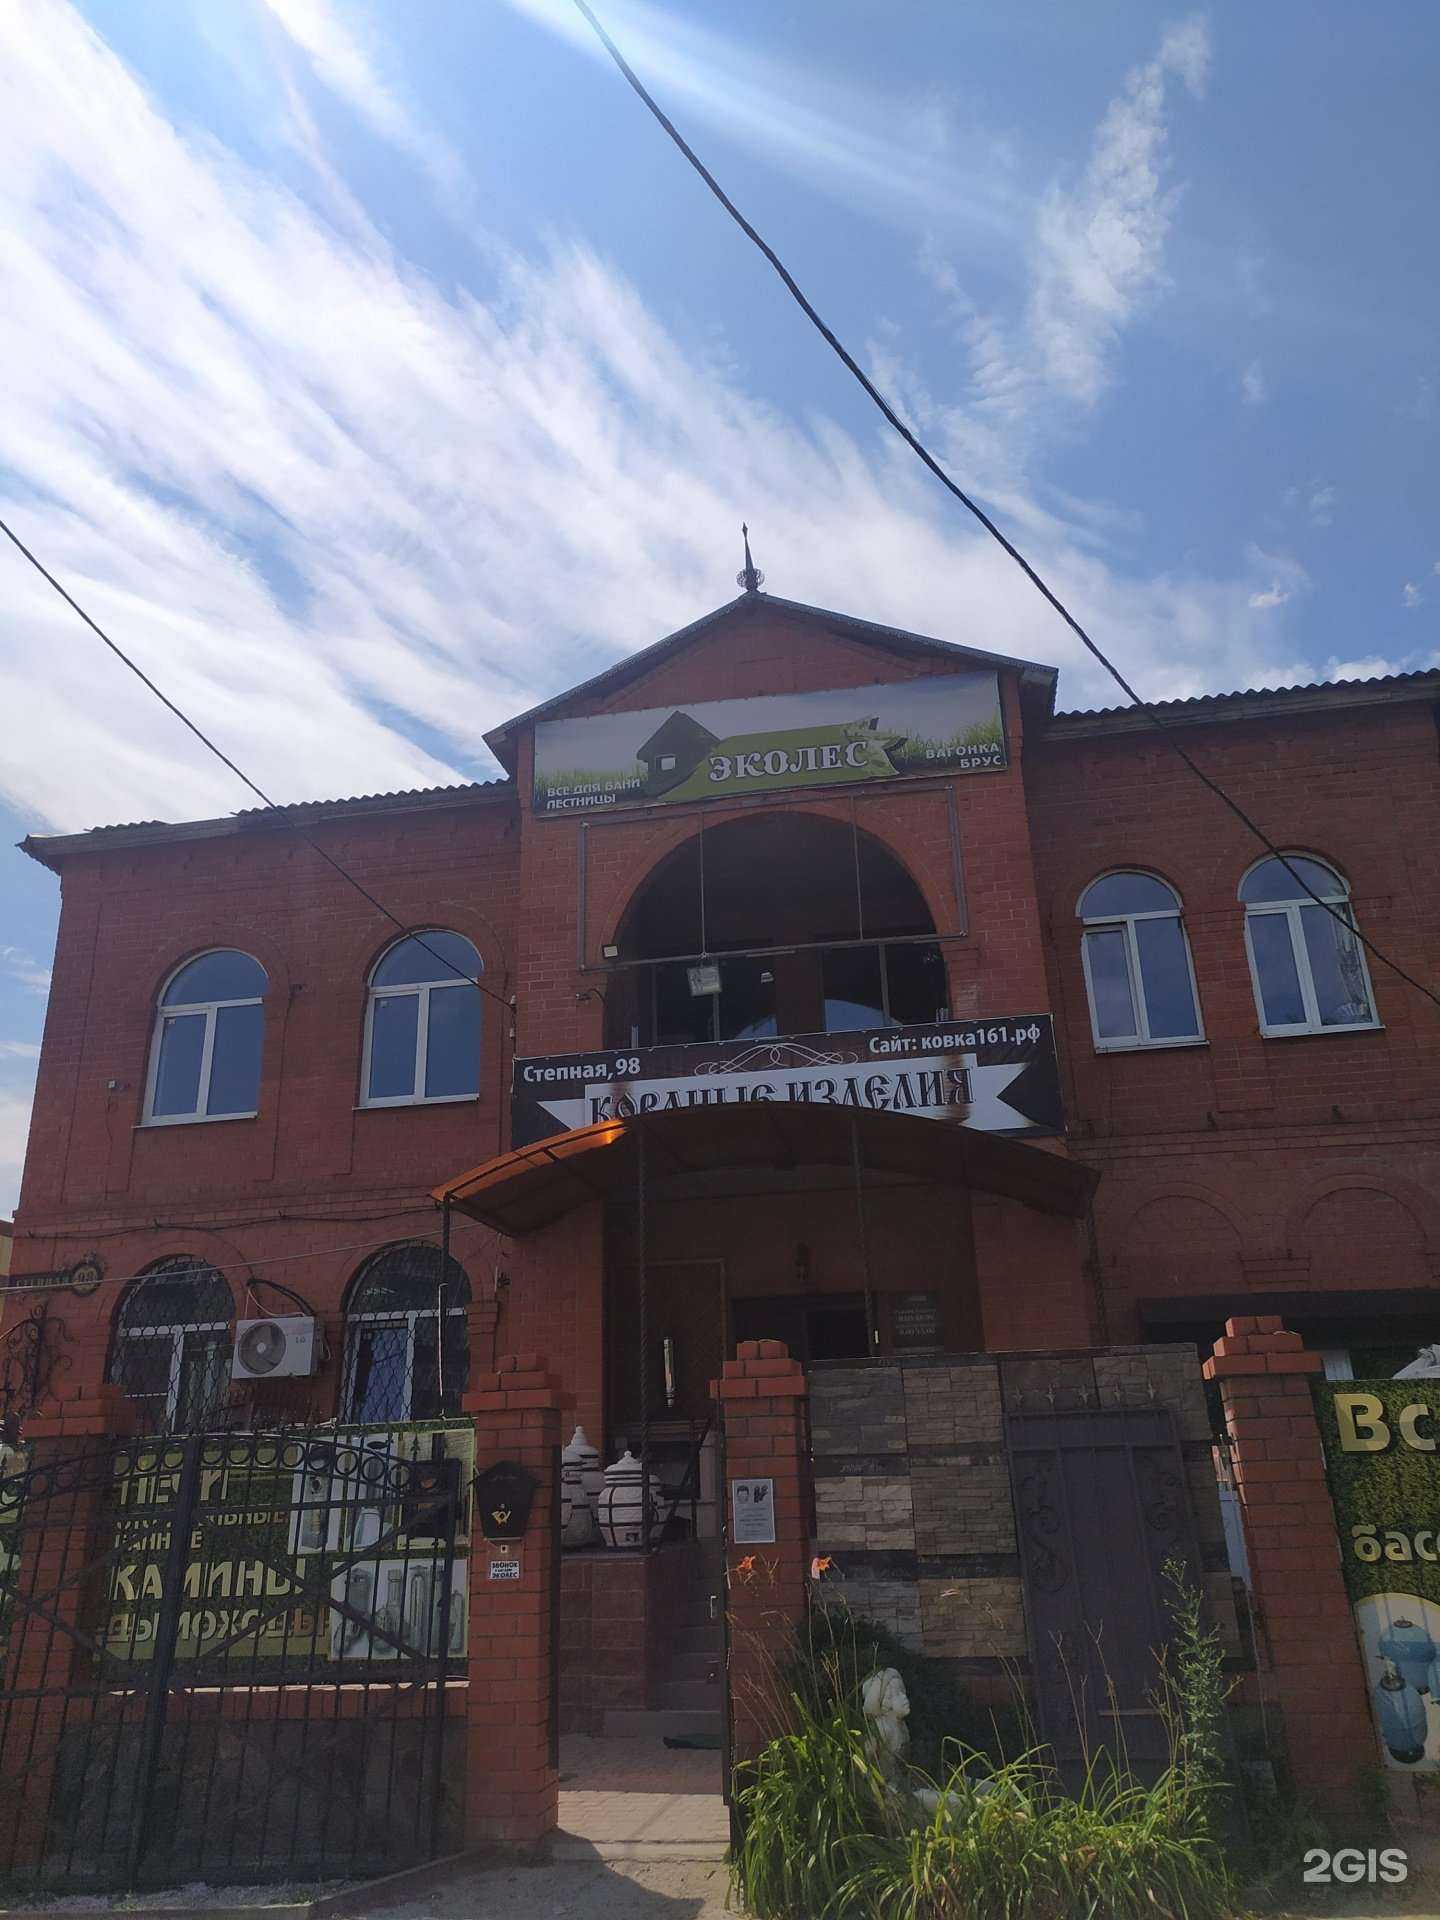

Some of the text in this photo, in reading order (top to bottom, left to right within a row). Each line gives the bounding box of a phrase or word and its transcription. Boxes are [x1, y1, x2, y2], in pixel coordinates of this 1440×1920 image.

[925, 742, 1000, 759] ВАГОНКА
[709, 741, 868, 782] ЭКОЛЕС
[959, 755, 1001, 769] БРУС
[546, 778, 641, 797] ВСЕ ДЛЯ БАНИ
[546, 793, 616, 810] ЛЕСТНИЦЫ
[869, 1023, 1041, 1054] Сайт: ковка161.рф
[1351, 1524, 1440, 1562] бас
